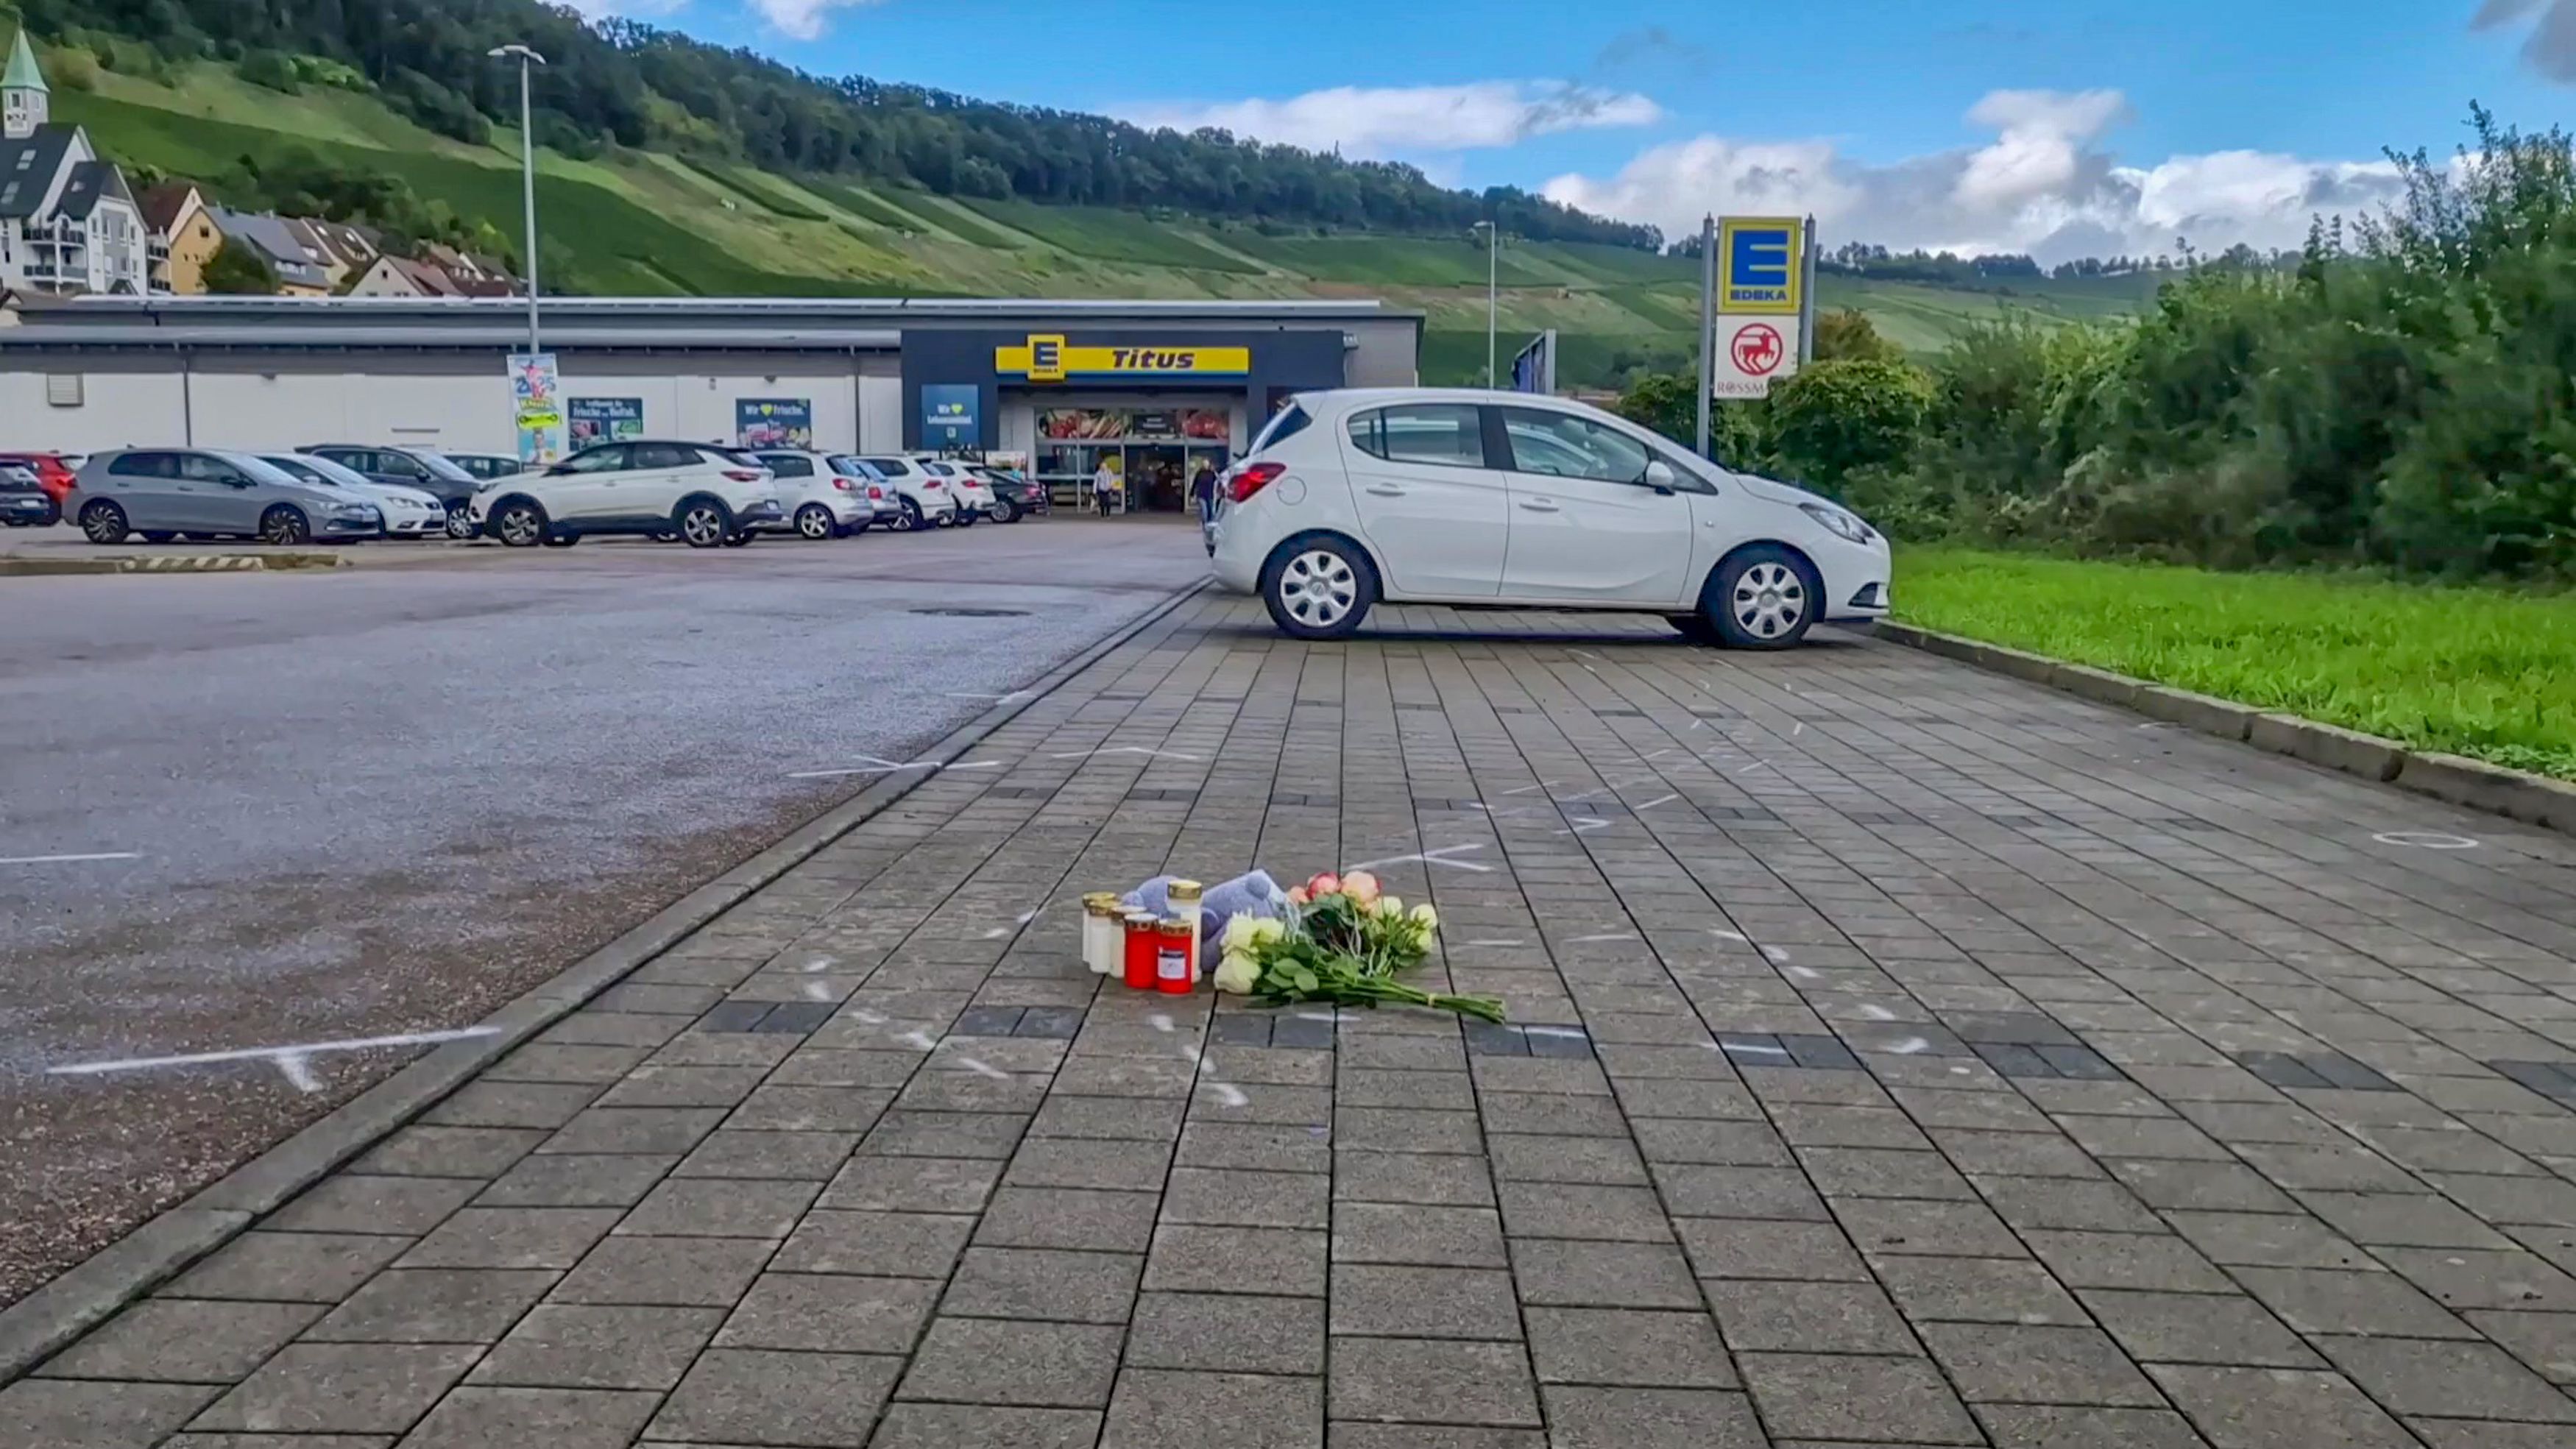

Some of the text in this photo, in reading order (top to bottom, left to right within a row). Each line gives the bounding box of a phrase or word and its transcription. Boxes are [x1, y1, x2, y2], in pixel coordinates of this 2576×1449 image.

[1732, 230, 1788, 286] E
[1730, 289, 1787, 301] EDEKA
[1033, 341, 1058, 366] E
[1111, 349, 1195, 369] Titus
[1716, 381, 1765, 394] ROSSM
